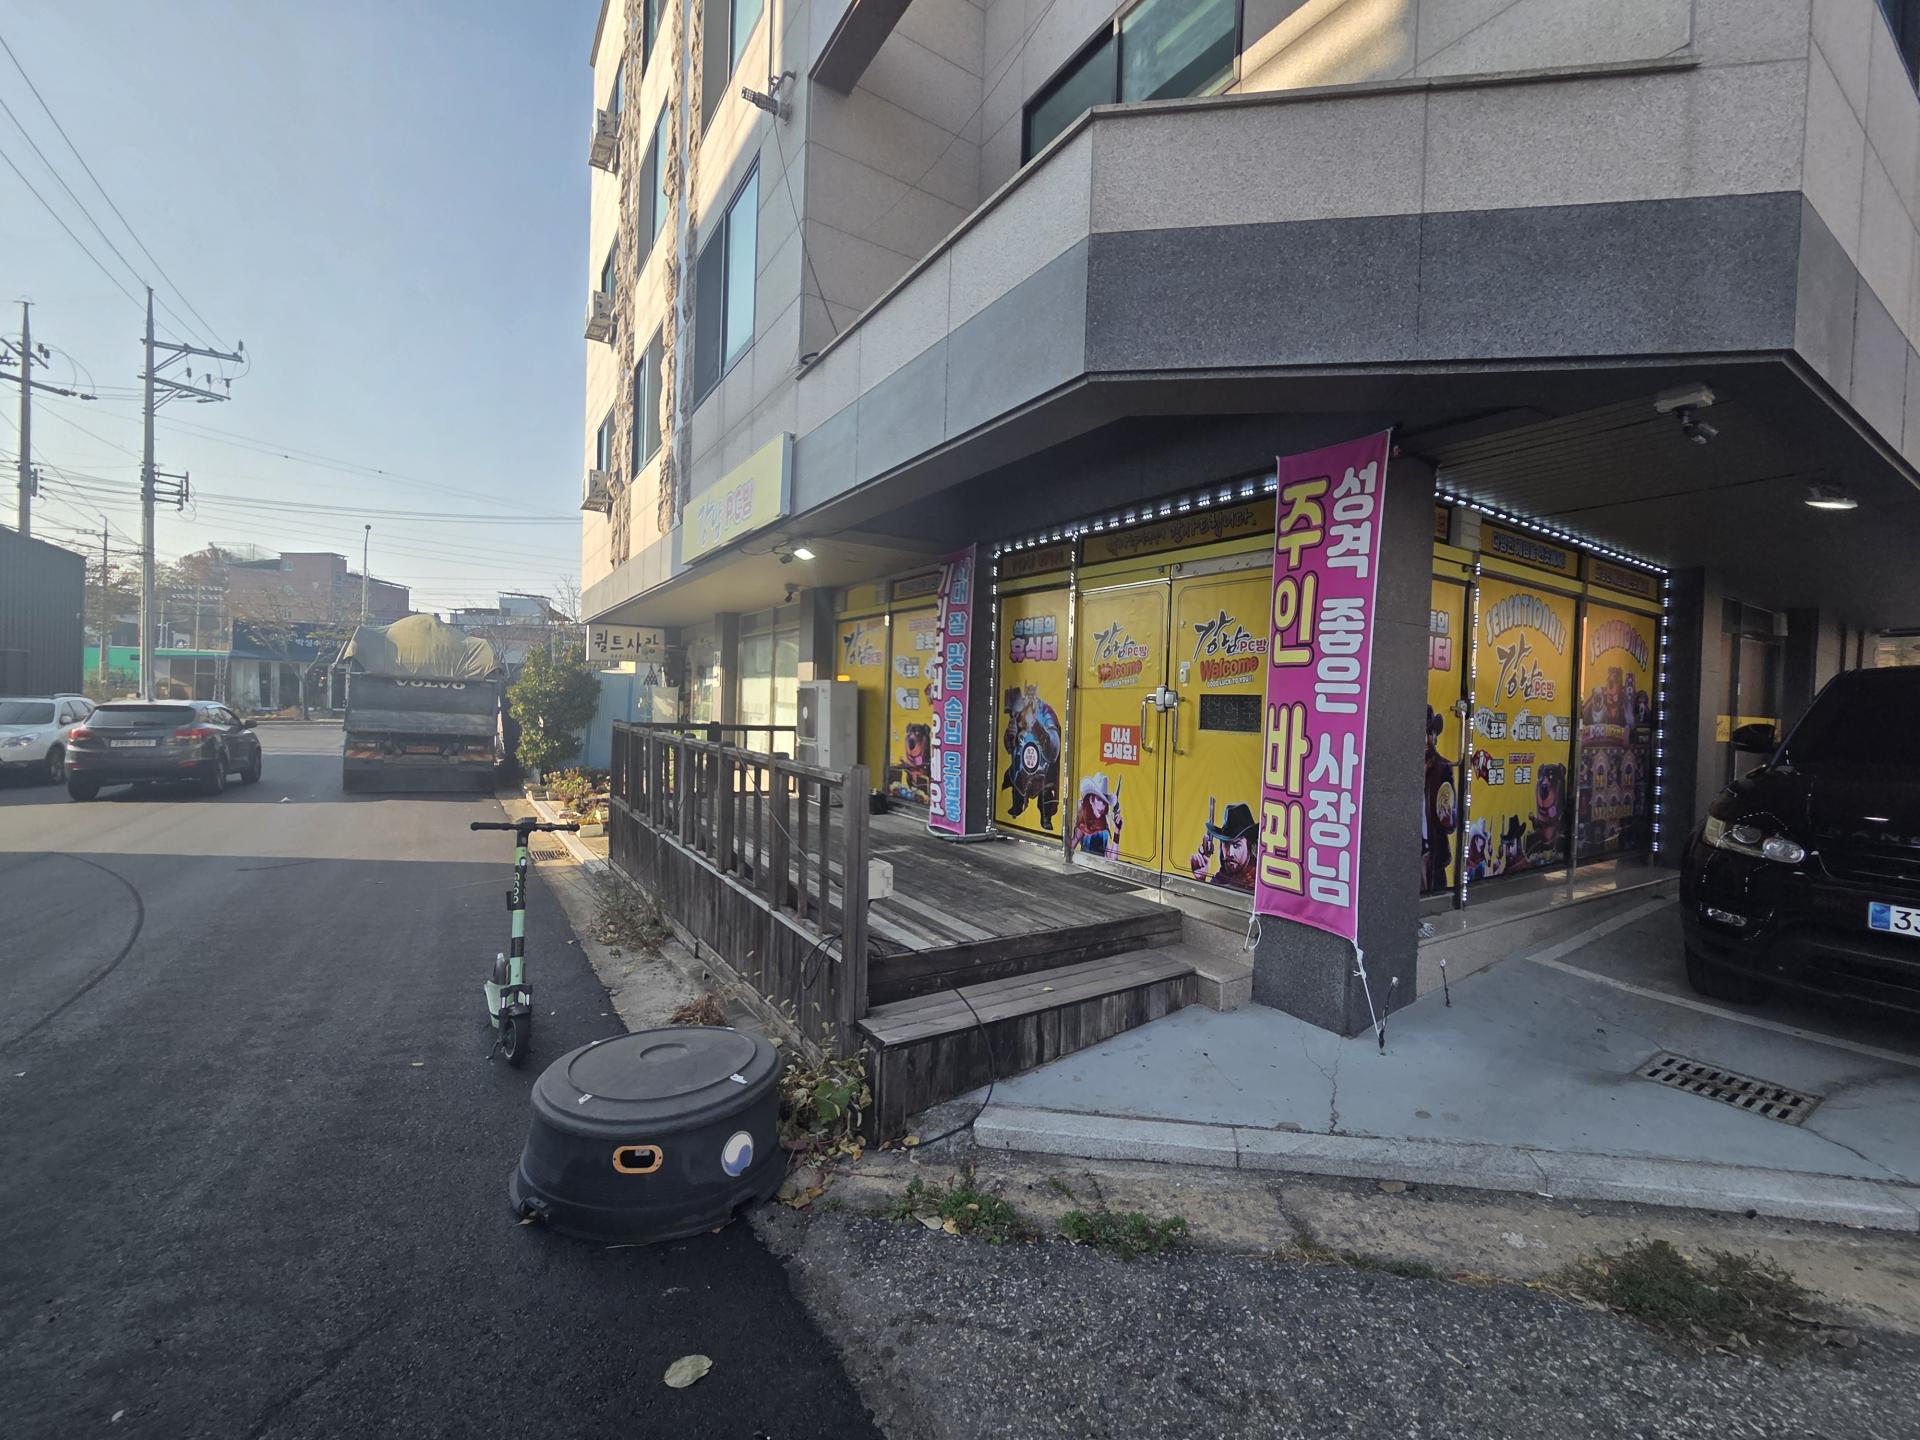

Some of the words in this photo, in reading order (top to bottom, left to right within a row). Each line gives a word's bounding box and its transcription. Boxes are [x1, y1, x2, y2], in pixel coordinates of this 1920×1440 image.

[1326, 460, 1378, 579] 성격
[1273, 476, 1331, 668] 주인
[1009, 633, 1059, 663] 휴식터
[1314, 597, 1366, 715] 좋은
[1428, 635, 1452, 672] 터
[395, 679, 466, 690] VOLVO
[1200, 656, 1259, 681] Welcome
[1103, 742, 1138, 761] 오세요!
[1111, 726, 1131, 744] 어서
[1261, 703, 1313, 896] 바뀜
[1307, 731, 1360, 908] 사장님
